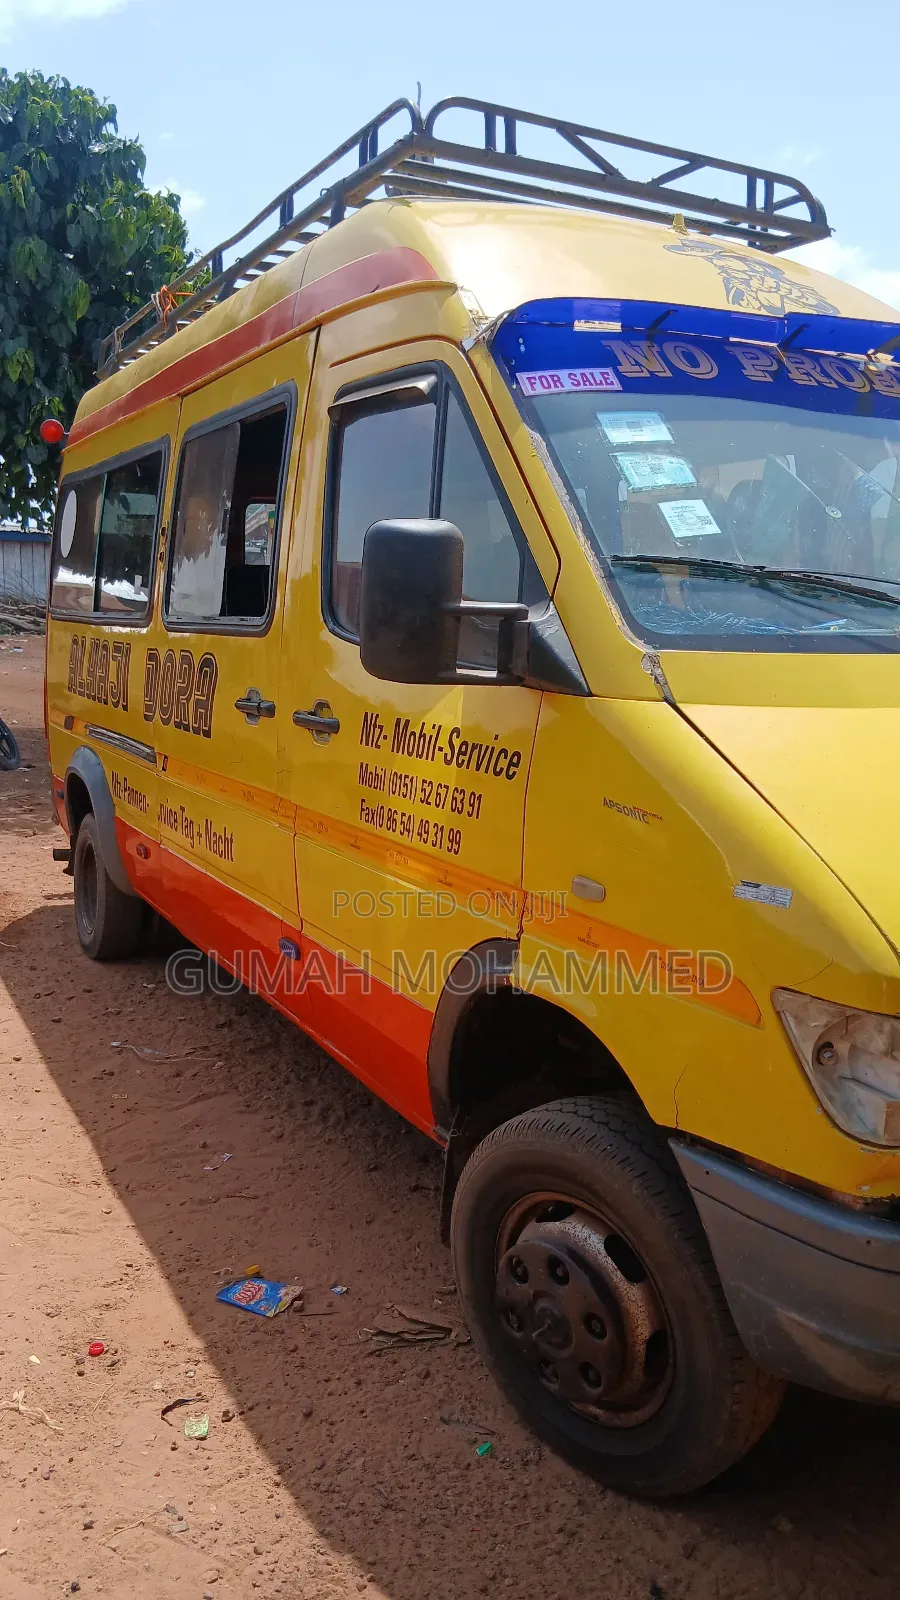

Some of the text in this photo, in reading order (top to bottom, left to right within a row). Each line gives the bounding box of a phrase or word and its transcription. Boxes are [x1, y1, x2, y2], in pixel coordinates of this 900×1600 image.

[526, 371, 615, 392] FOR SALE
[601, 340, 719, 379] NO
[67, 634, 219, 739] ALHAJI DORA
[359, 711, 522, 781] Nfz- Mobil-Service
[358, 762, 483, 820] Mobil (0151) 52 67 63 91
[602, 796, 649, 825] APSONIC
[180, 804, 195, 849] Tag
[196, 824, 203, 845] +
[205, 818, 234, 863] Nacht
[385, 807, 398, 834] 86
[399, 812, 415, 844] 54)
[416, 818, 430, 845] 49
[431, 822, 445, 850] 31
[446, 827, 462, 856] 99
